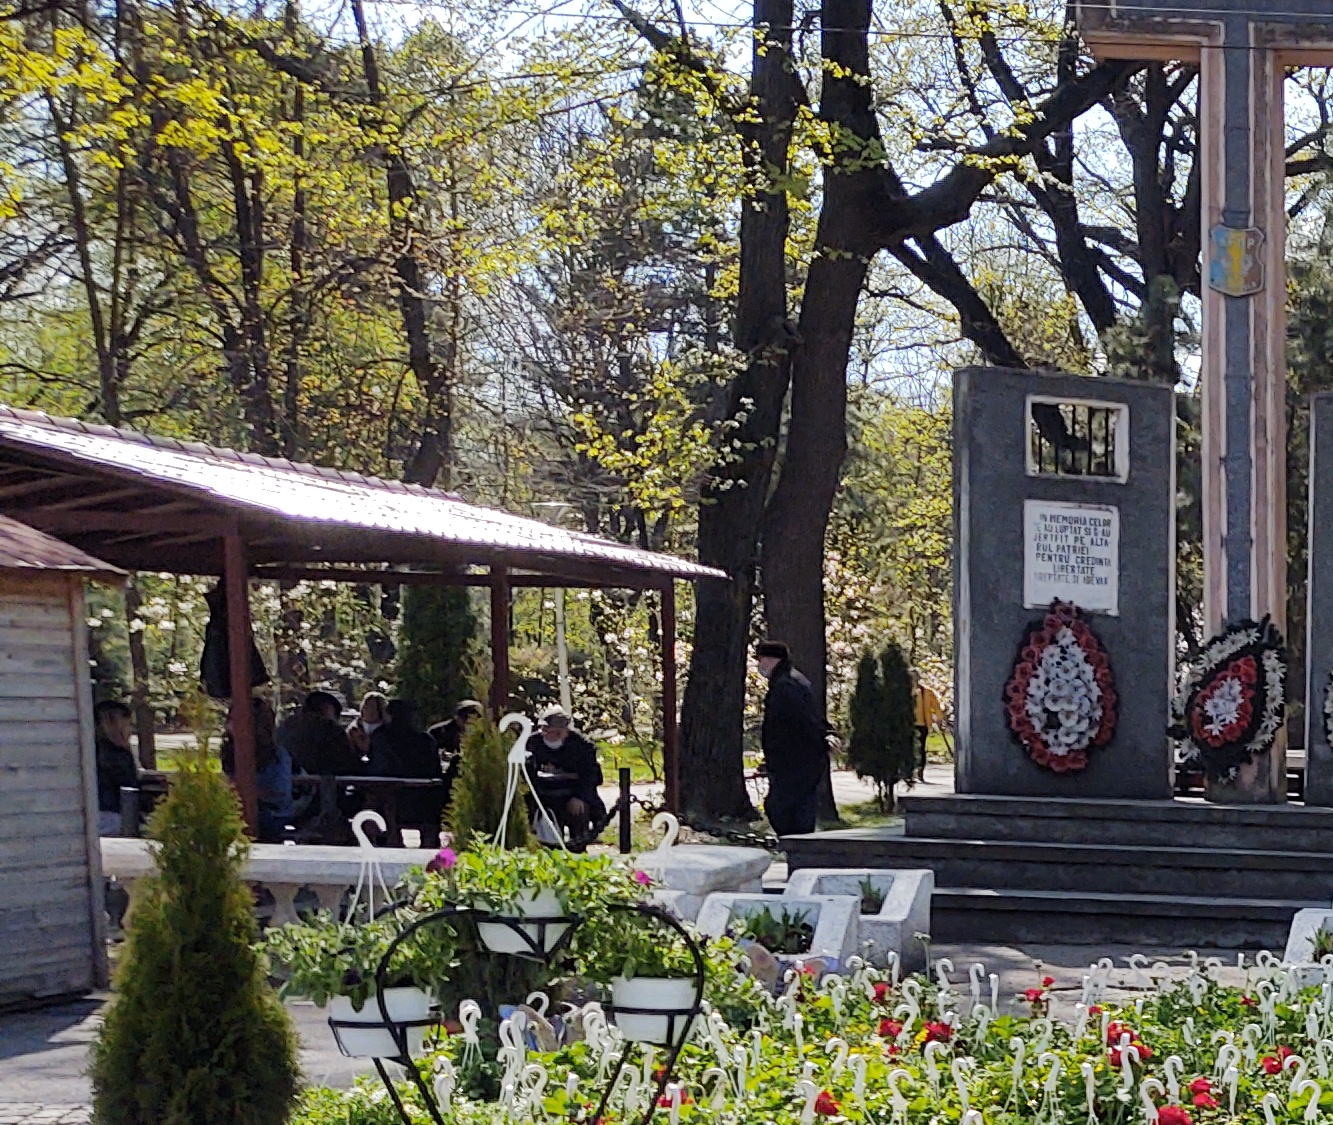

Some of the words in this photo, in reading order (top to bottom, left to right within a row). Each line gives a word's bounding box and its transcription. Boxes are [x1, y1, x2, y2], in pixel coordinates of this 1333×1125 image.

[1049, 514, 1087, 525] MEMORIA
[1089, 517, 1112, 527] CELOR
[1055, 525, 1082, 535] LUPTAT
[1073, 535, 1086, 545] PE
[1036, 542, 1054, 552] RUL
[1056, 543, 1089, 555] PATRIEI
[1035, 552, 1070, 563] PENTRU
[1053, 563, 1095, 574] LIBERTATE
